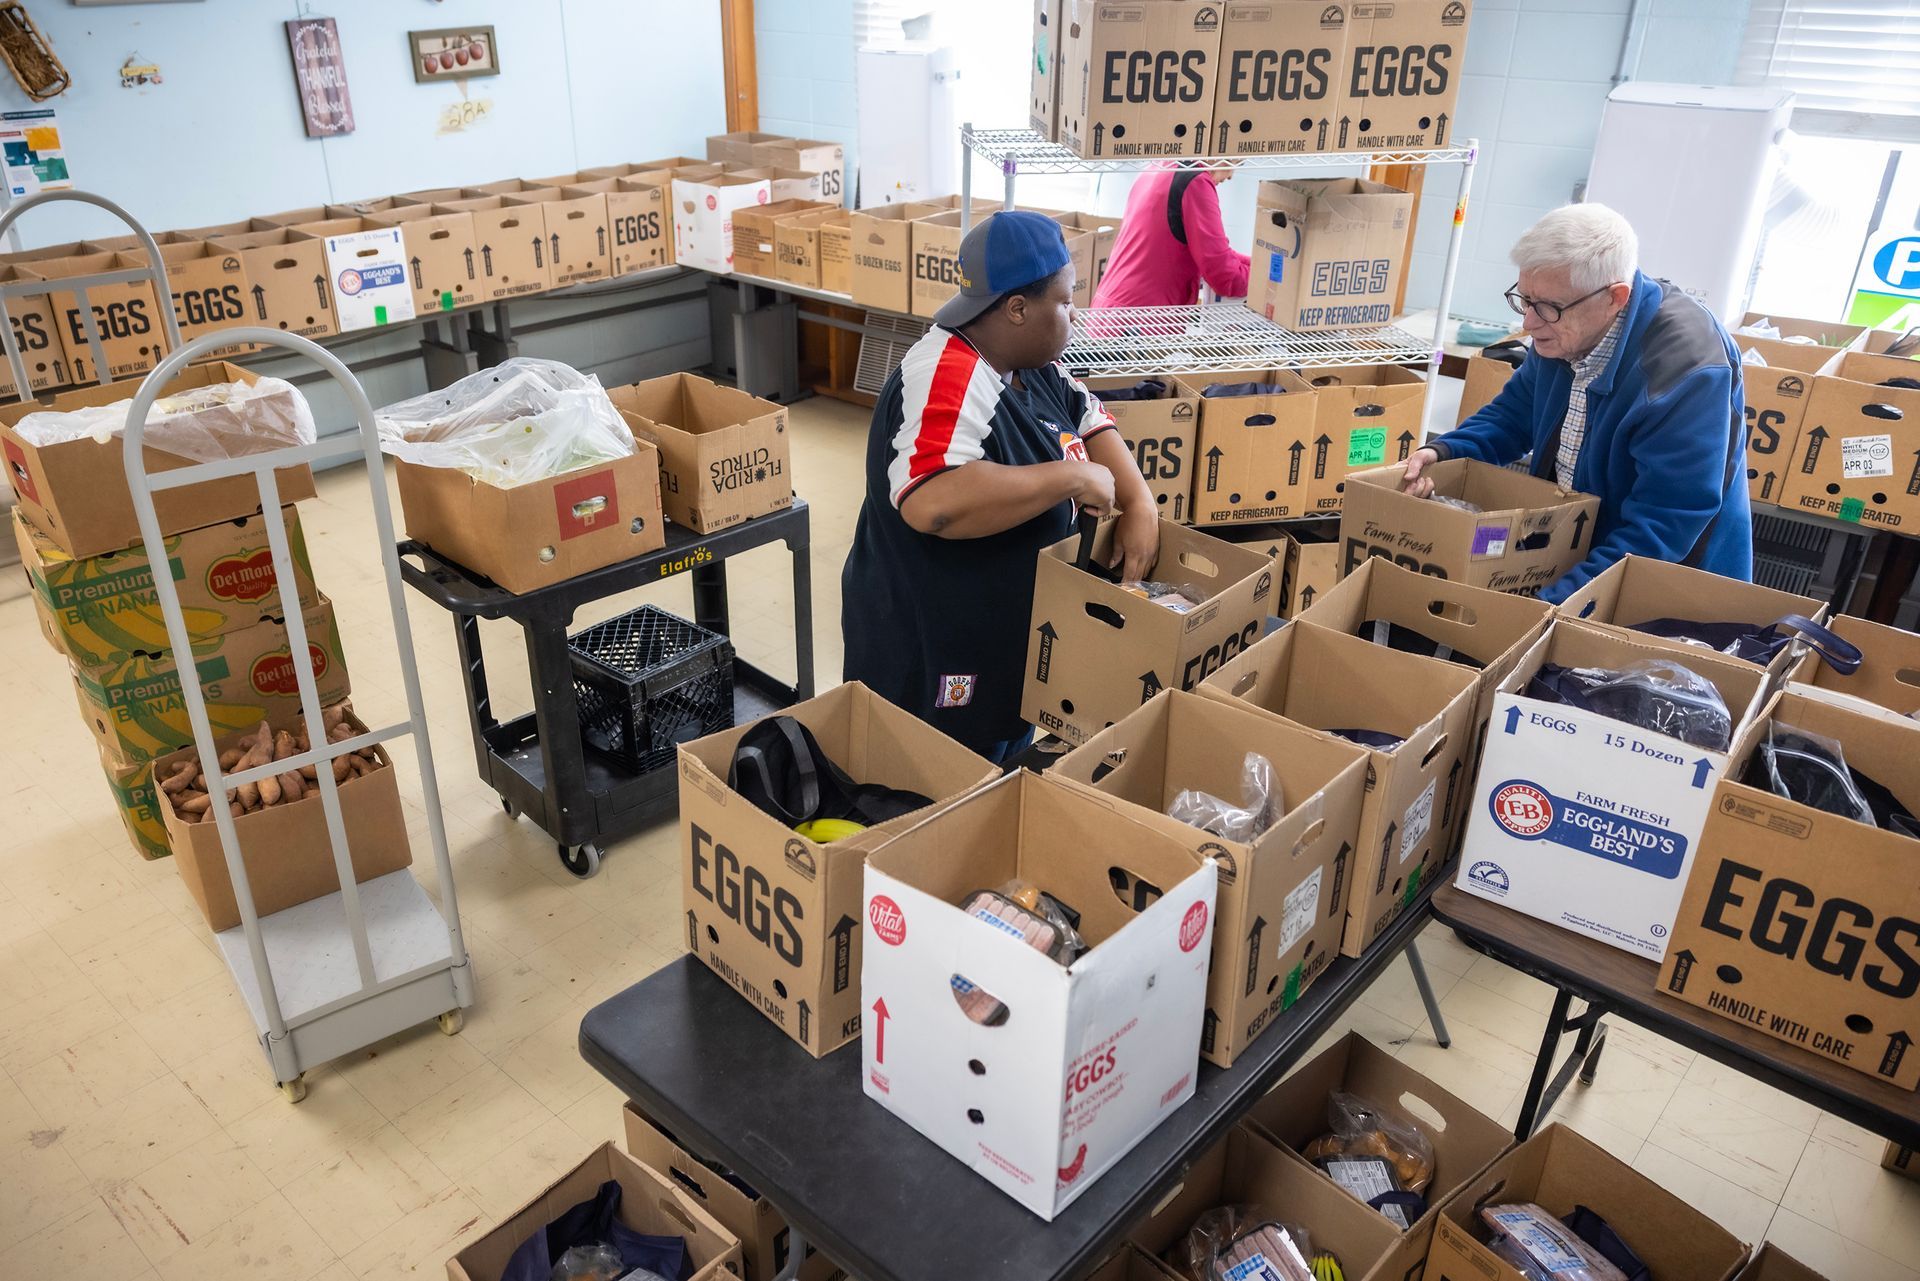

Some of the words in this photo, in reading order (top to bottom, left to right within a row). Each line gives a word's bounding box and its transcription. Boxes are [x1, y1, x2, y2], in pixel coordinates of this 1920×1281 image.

[300, 66, 345, 90] THANKFUL
[1102, 50, 1206, 103] EGGS
[1229, 48, 1331, 102] EGGS
[1350, 44, 1452, 98] EGGS
[1113, 144, 1142, 155] HANDLE
[1144, 143, 1162, 155] WITH
[1164, 143, 1182, 154] CARE
[1238, 141, 1265, 152] HANDLE
[1268, 140, 1285, 152] WITH
[1288, 140, 1306, 151] CARE
[1357, 136, 1384, 148] HANDLE
[1386, 135, 1403, 147] WITH
[1405, 135, 1424, 146] CARE
[822, 169, 840, 197] GS
[615, 211, 661, 246] EGGS
[863, 255, 883, 269] DOZEN
[885, 260, 902, 272] EGGS
[1311, 259, 1390, 297] EGGS
[171, 284, 244, 327] EGGS
[1299, 308, 1322, 327] KEEP
[1325, 304, 1391, 326] REFRIGERATED
[710, 448, 769, 479] CITRUS
[1349, 450, 1363, 459] APR
[1844, 461, 1861, 471] APR
[1863, 460, 1873, 470] 03
[1211, 511, 1231, 522] KEEP
[1233, 505, 1289, 519] REFRIGERATED
[1317, 498, 1334, 508] KEEP
[1800, 495, 1826, 510] KEEP
[1363, 520, 1396, 543] Farm
[1397, 531, 1433, 555] Fresh
[213, 571, 239, 590] Del
[1488, 570, 1521, 588] Farm
[1522, 565, 1557, 582] Fresh
[1044, 635, 1050, 646] UP
[256, 667, 279, 685] Del
[1147, 684, 1154, 696] UP
[1039, 709, 1063, 731] KEEP
[1530, 711, 1577, 735] EGGS
[1604, 733, 1625, 748] 15
[1631, 741, 1685, 765] Dozen
[1499, 786, 1545, 801] QUALITY
[1507, 800, 1540, 820] EB
[1576, 791, 1617, 811] FARM
[1620, 805, 1671, 827] FRESH
[1499, 813, 1550, 833] APPROVED
[1590, 834, 1640, 860] BEST
[691, 821, 804, 968] EGGS
[869, 903, 902, 933] Vital
[1701, 857, 1920, 1000] EGGS
[840, 931, 848, 944] UP
[839, 946, 848, 964] END
[710, 951, 740, 988] HANDLE
[741, 976, 762, 1007] WITH
[764, 997, 785, 1026] CARE
[842, 1015, 862, 1039] KEE
[1247, 1010, 1268, 1040] KEEP
[1708, 990, 1767, 1026] HANDLE
[1769, 1013, 1810, 1043] WITH
[1812, 1032, 1855, 1060] CARE
[1065, 1045, 1116, 1103] EGGS
